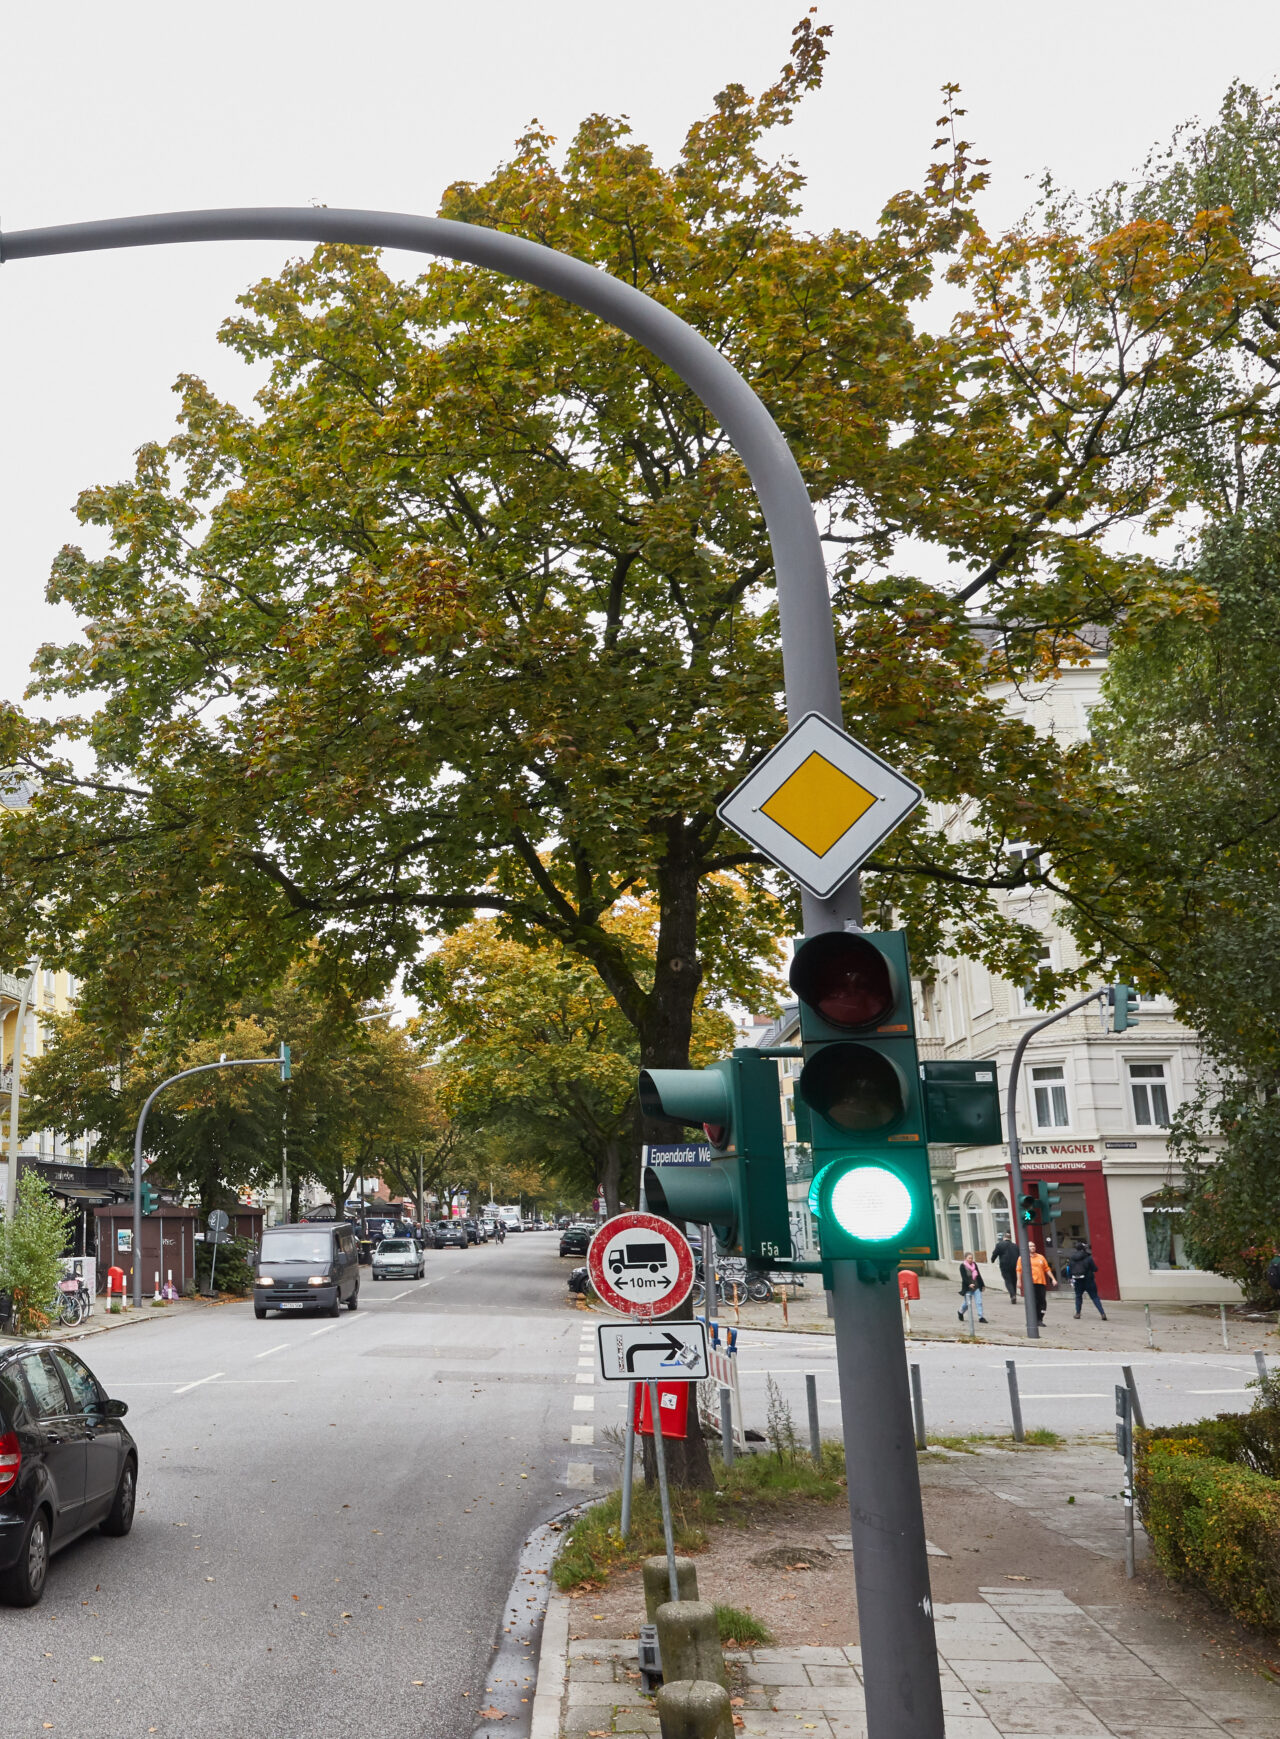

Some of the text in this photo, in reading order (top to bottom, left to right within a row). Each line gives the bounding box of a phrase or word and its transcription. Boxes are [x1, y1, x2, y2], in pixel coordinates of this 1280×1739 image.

[1017, 1146, 1048, 1155] LIVER
[1050, 1145, 1095, 1154] WAGNER
[651, 1147, 711, 1167] Eppendorfer We
[761, 1242, 779, 1256] F5a
[630, 1278, 656, 1288] 10m
